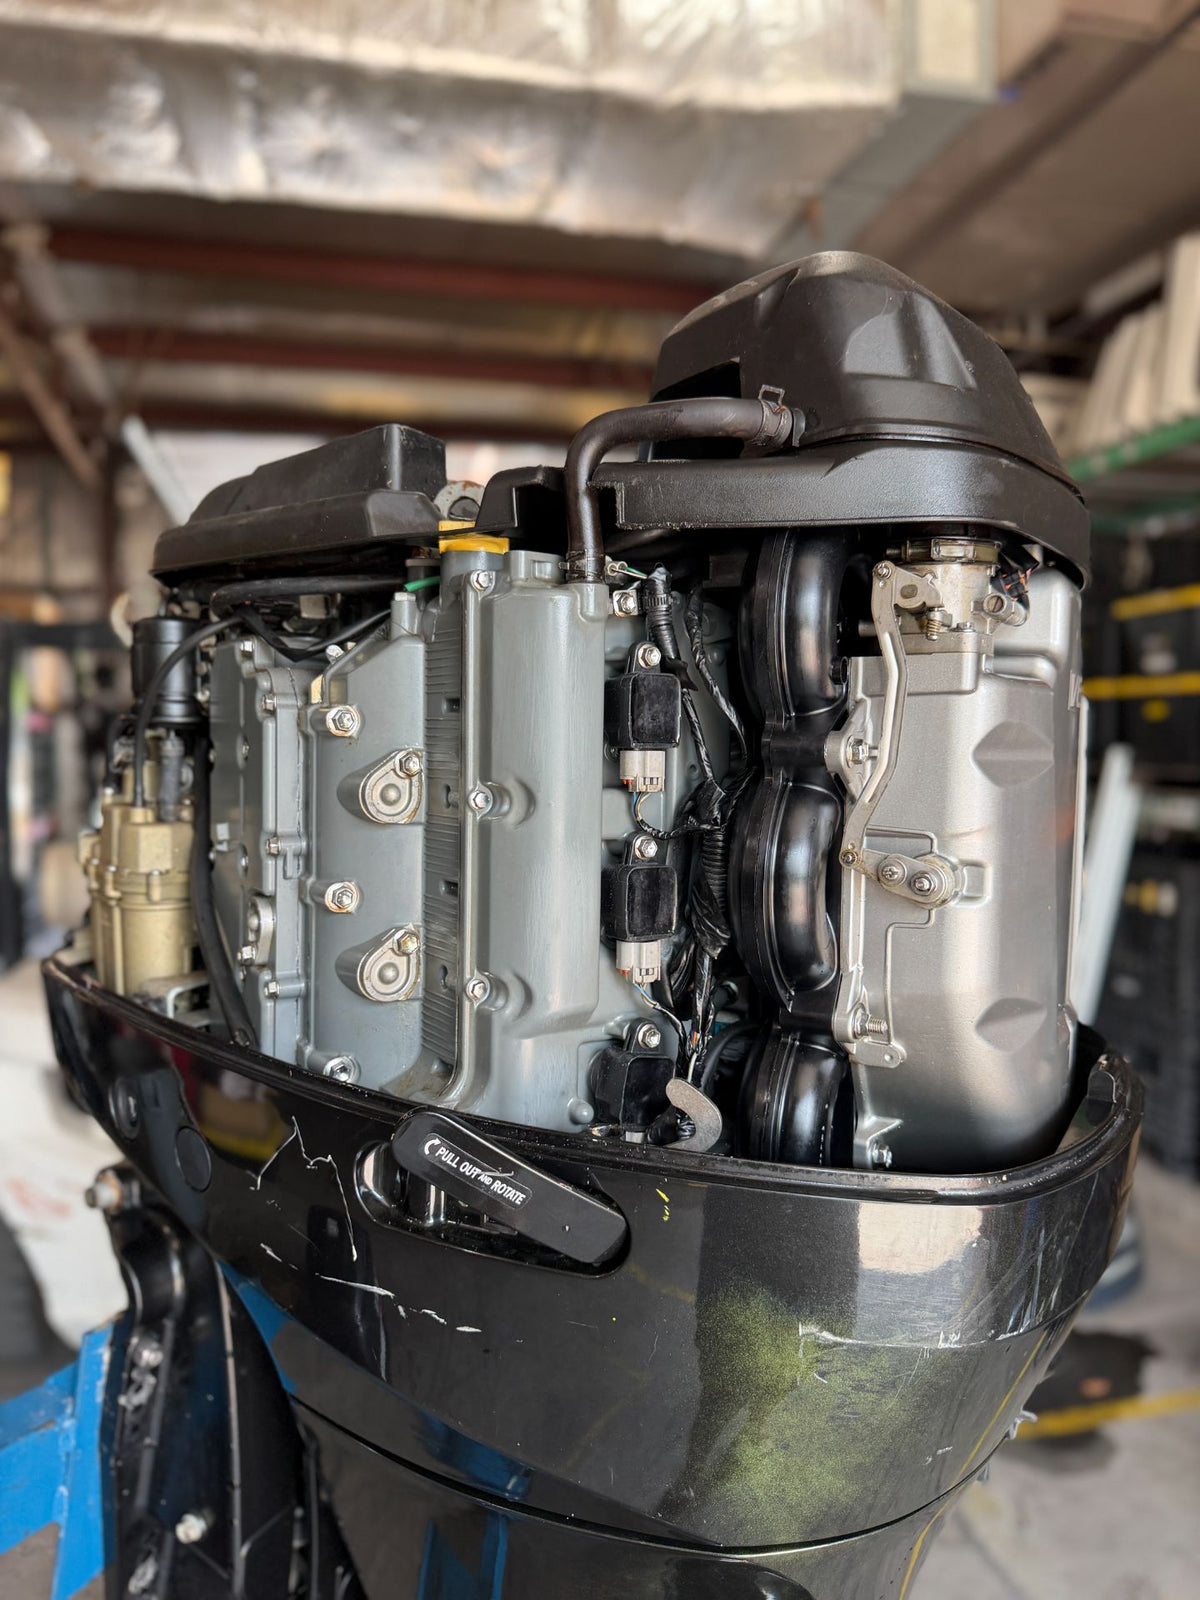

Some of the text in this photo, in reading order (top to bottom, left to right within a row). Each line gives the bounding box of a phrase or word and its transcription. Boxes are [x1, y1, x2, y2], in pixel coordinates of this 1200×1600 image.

[435, 1146, 526, 1205] PULL OUT AND ROTATE
